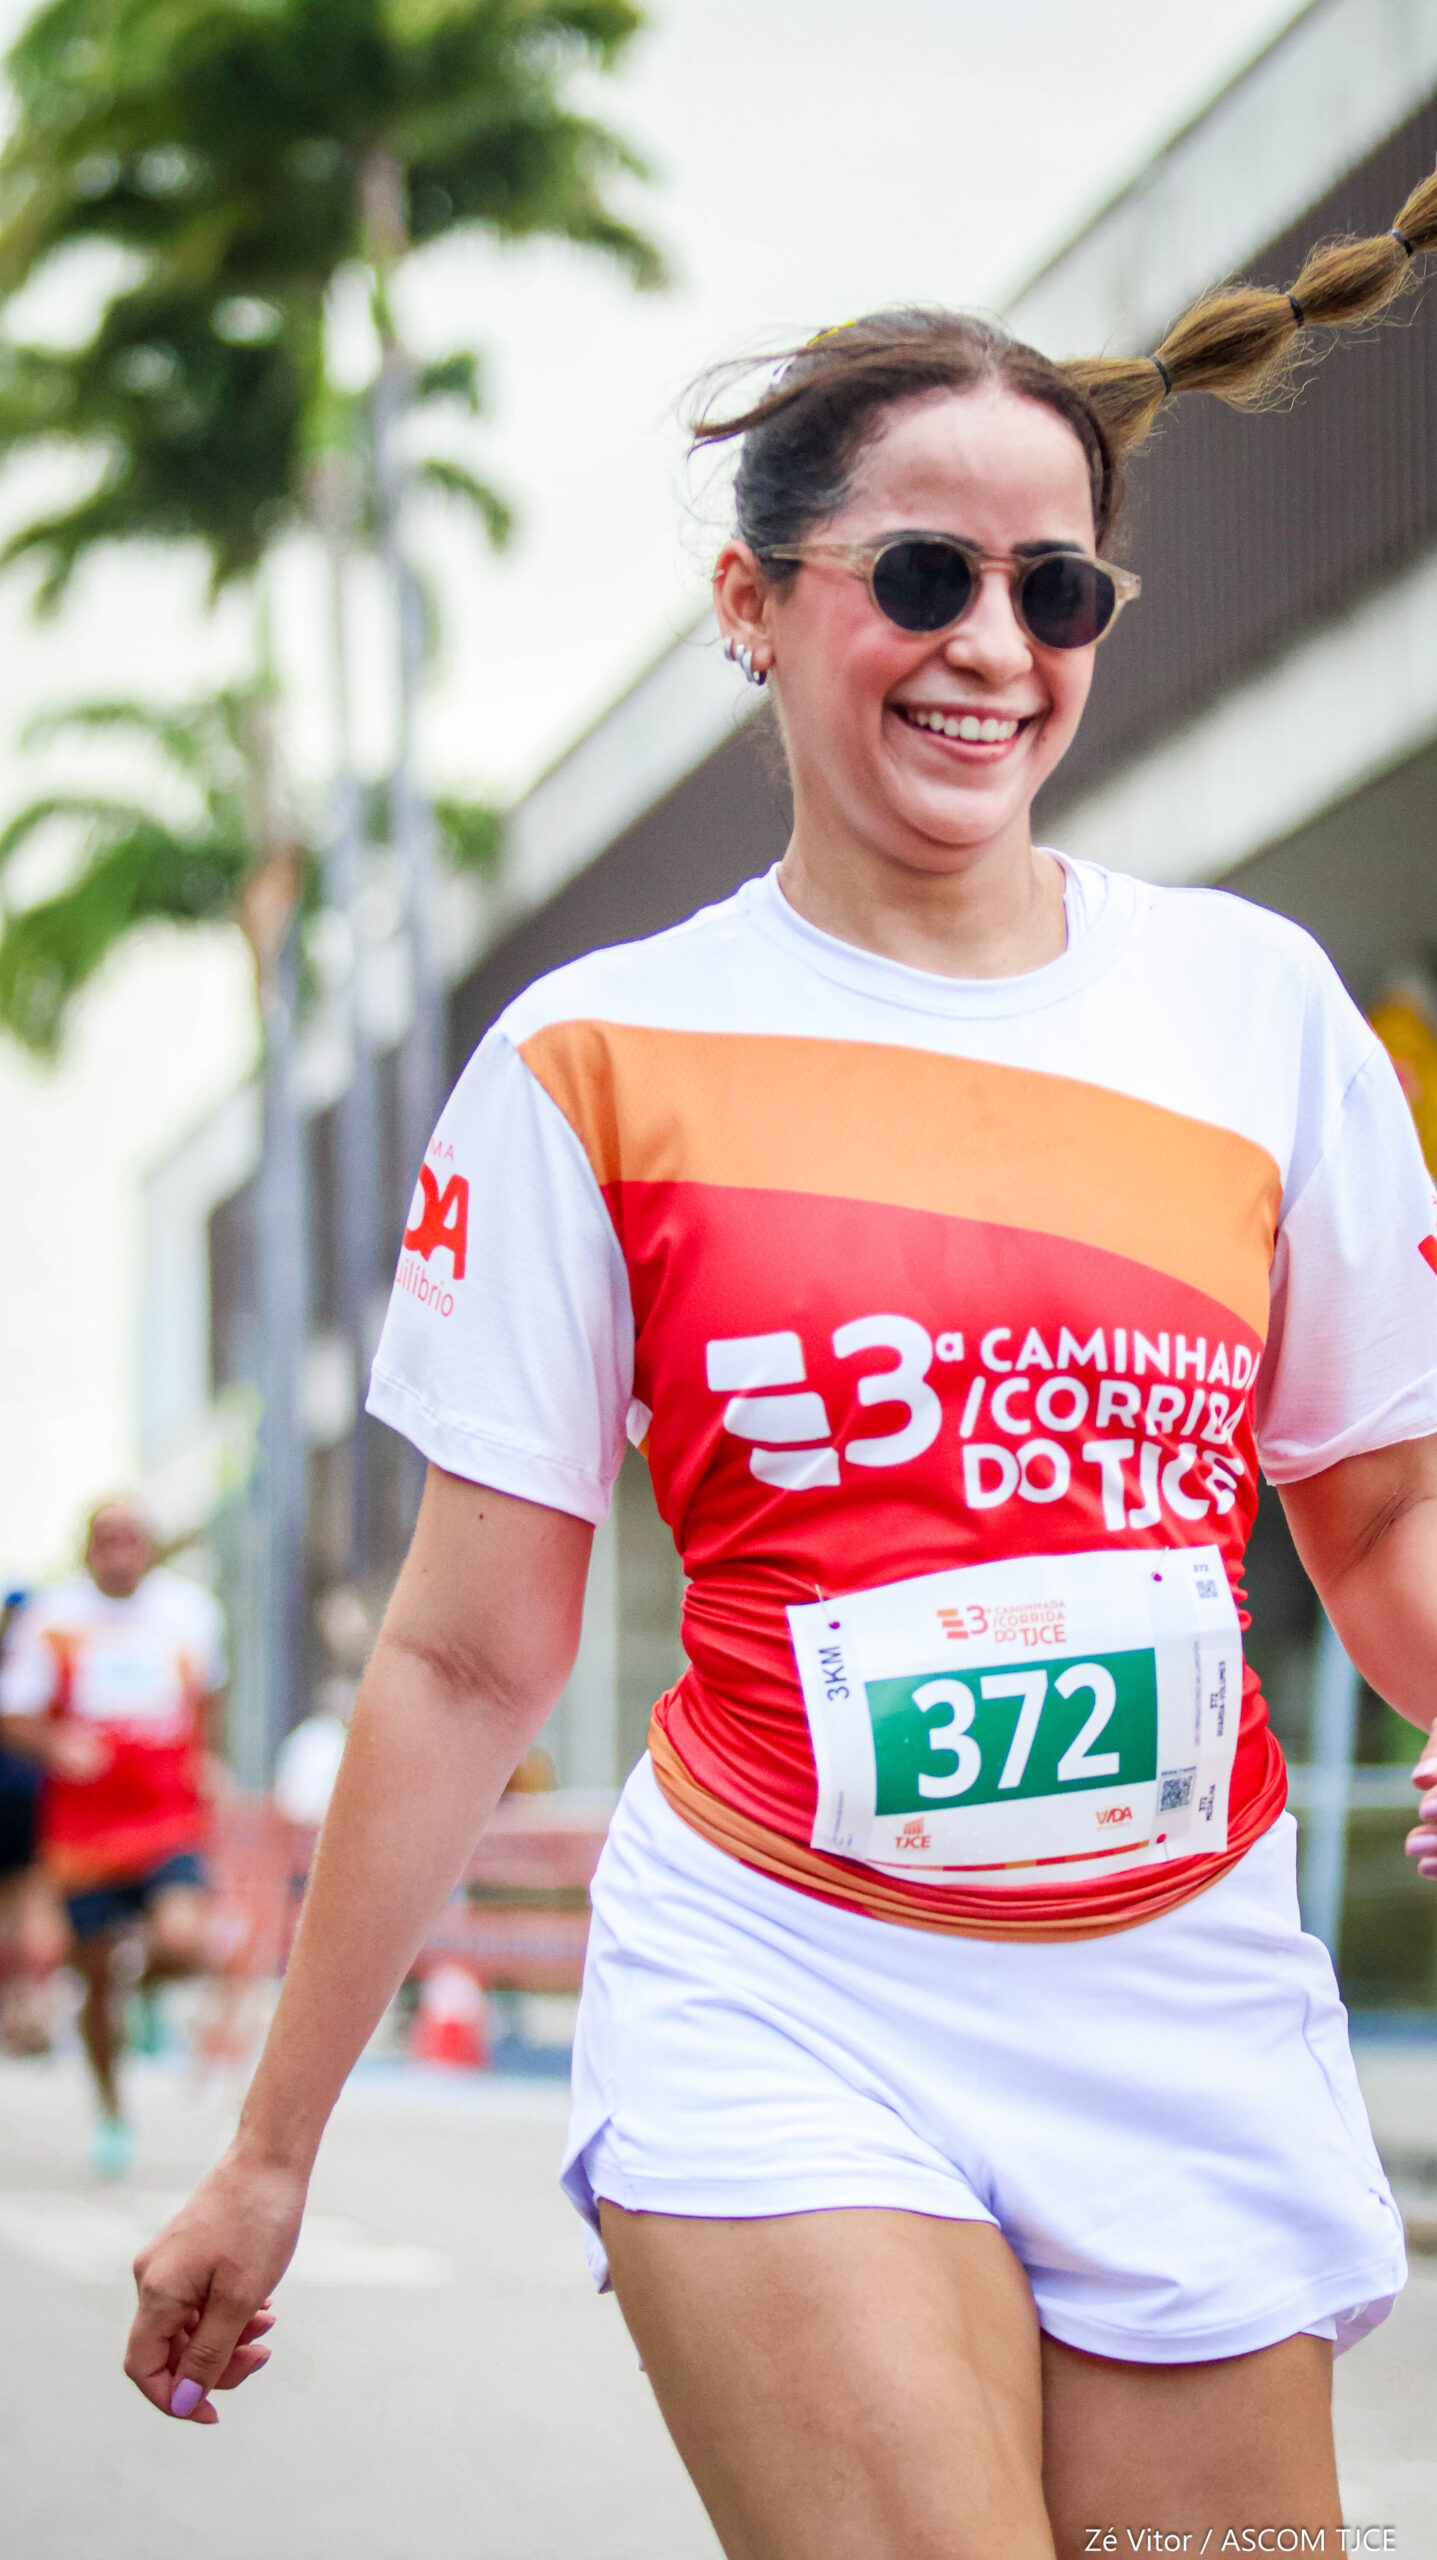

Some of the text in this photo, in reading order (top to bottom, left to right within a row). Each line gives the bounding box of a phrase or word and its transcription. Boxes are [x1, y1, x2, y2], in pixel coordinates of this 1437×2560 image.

[962, 1437, 1245, 1531] DO TJCE
[995, 1624, 1067, 1647] DO TJCE
[818, 1646, 850, 1701] 3KM
[912, 1662, 1120, 1799] 372
[895, 1835, 931, 1849] TJCE
